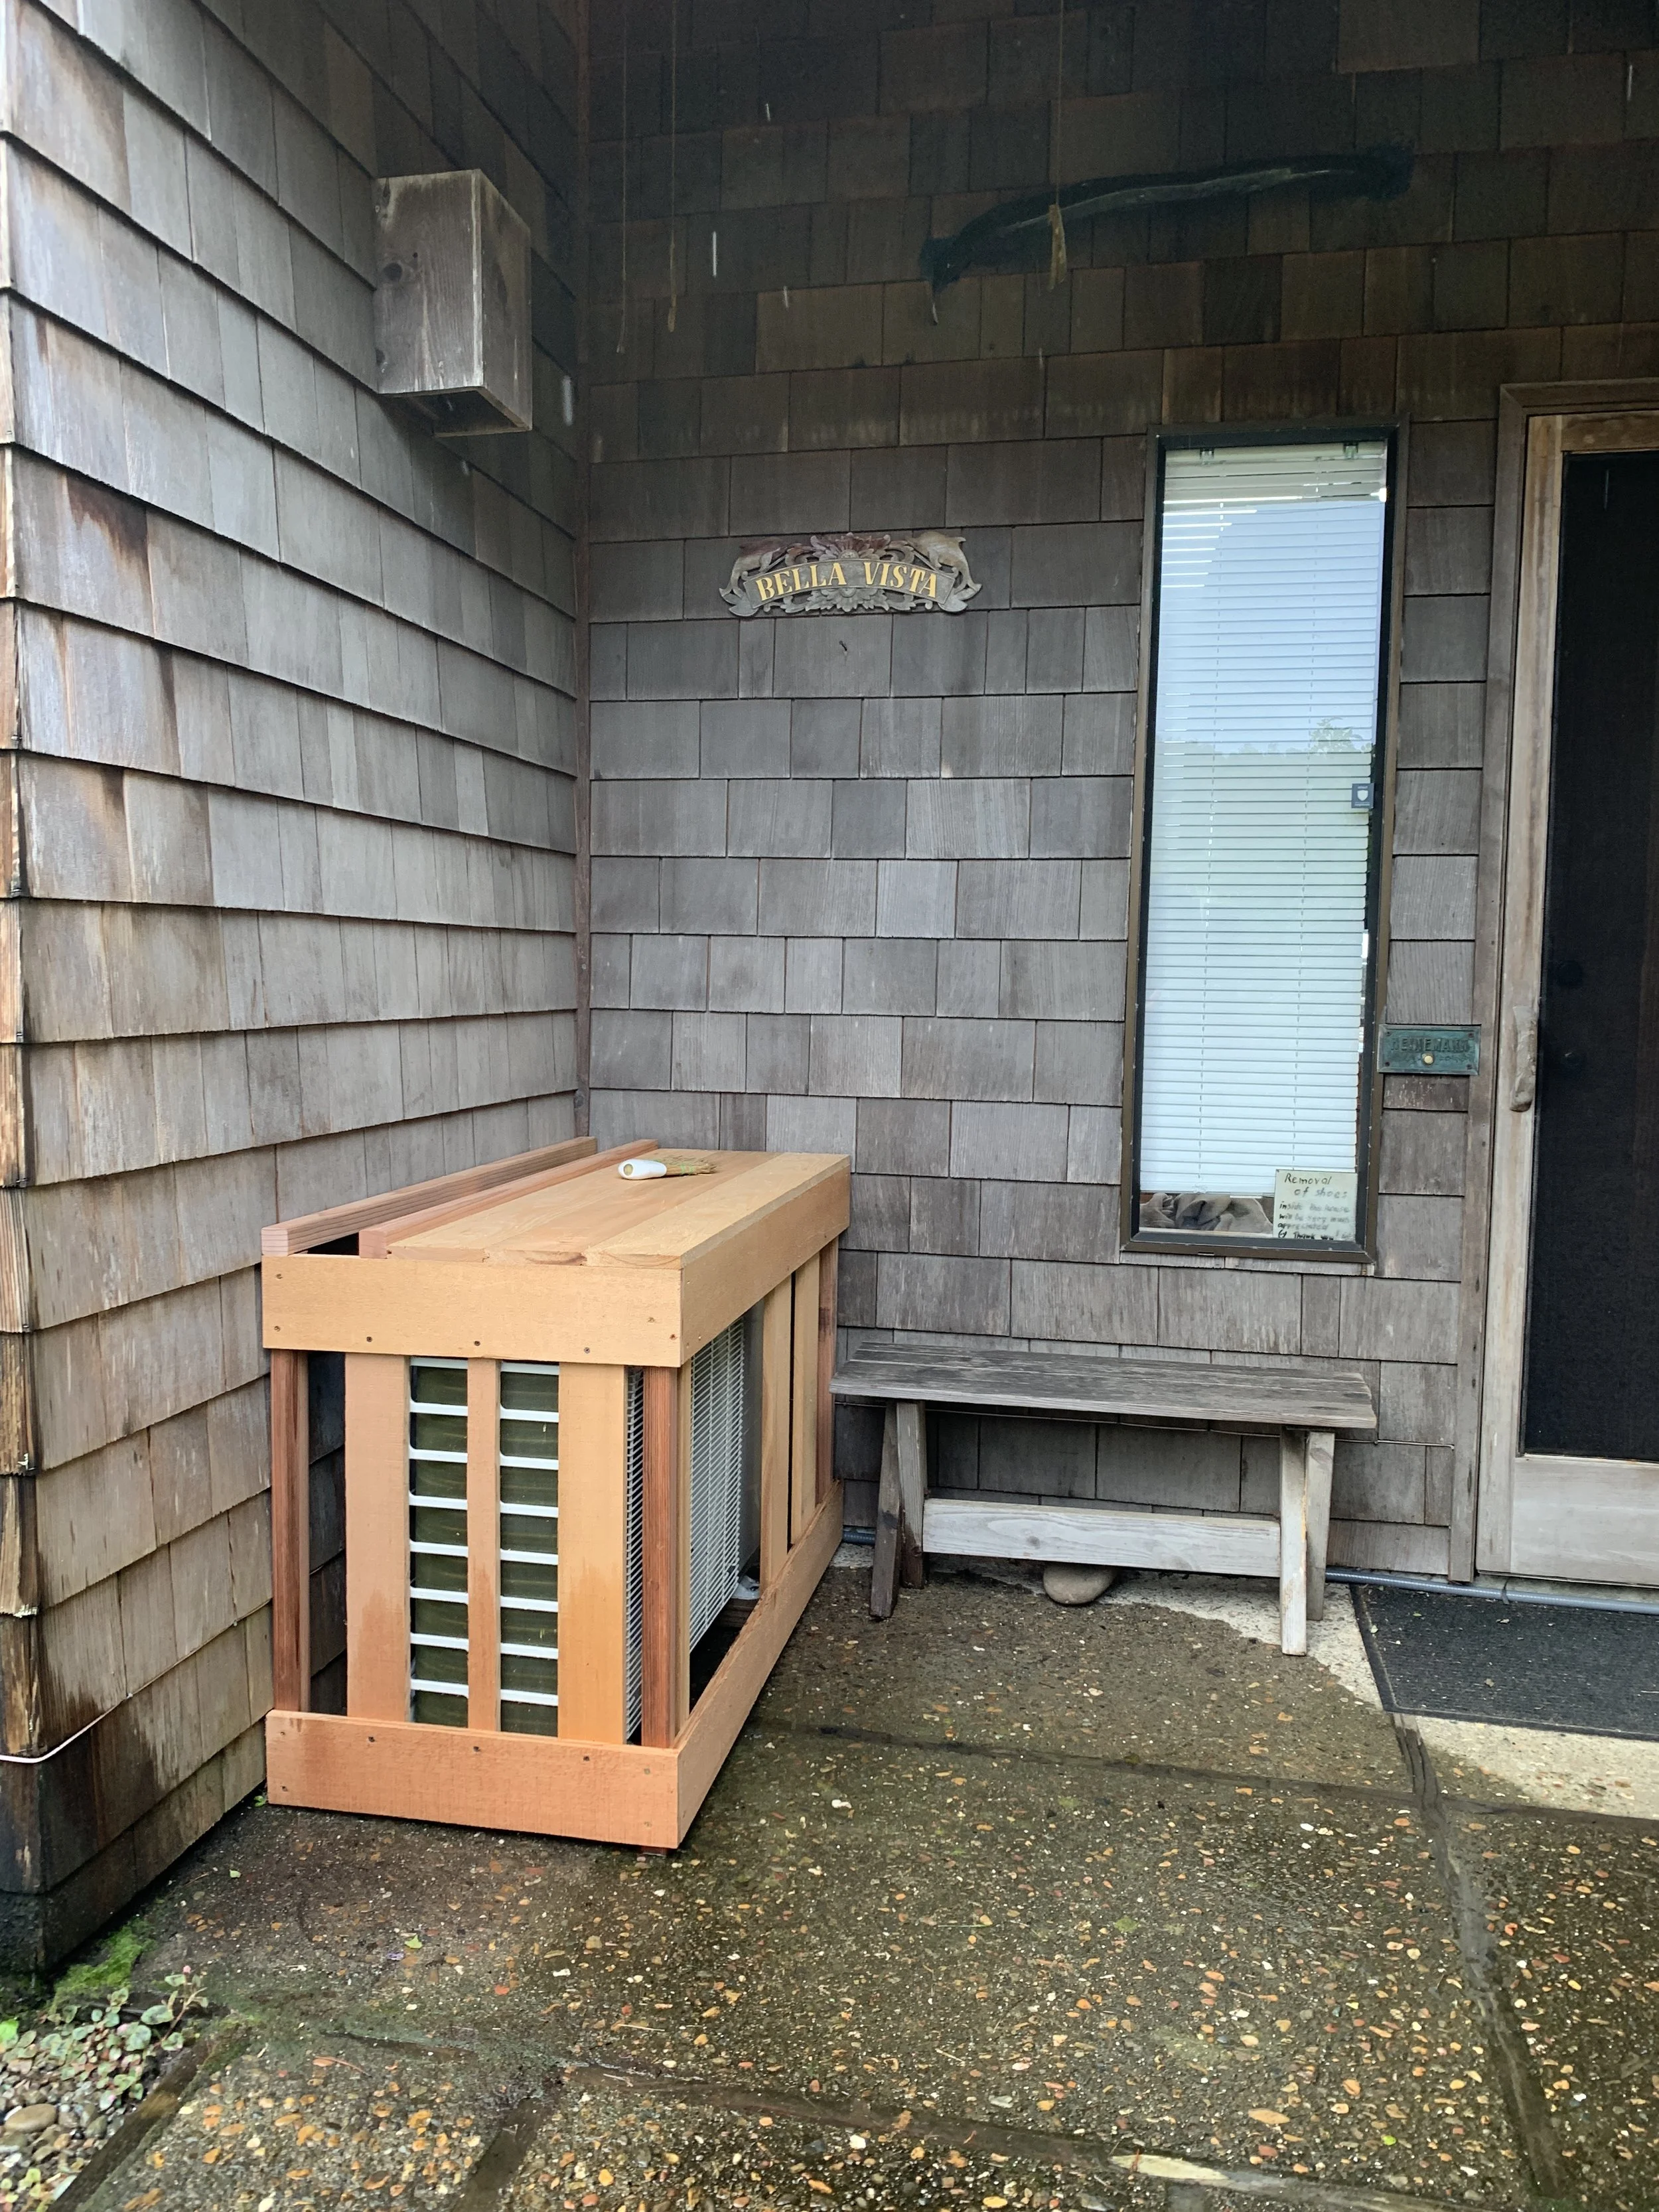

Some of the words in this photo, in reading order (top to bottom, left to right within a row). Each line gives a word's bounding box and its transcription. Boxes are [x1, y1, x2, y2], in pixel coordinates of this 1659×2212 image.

[755, 562, 847, 601] BELLA
[863, 561, 937, 598] VISTA
[1284, 1173, 1333, 1185] Removal
[1294, 1187, 1309, 1197] of
[1315, 1187, 1348, 1199] shoes
[1279, 1201, 1302, 1210] inside
